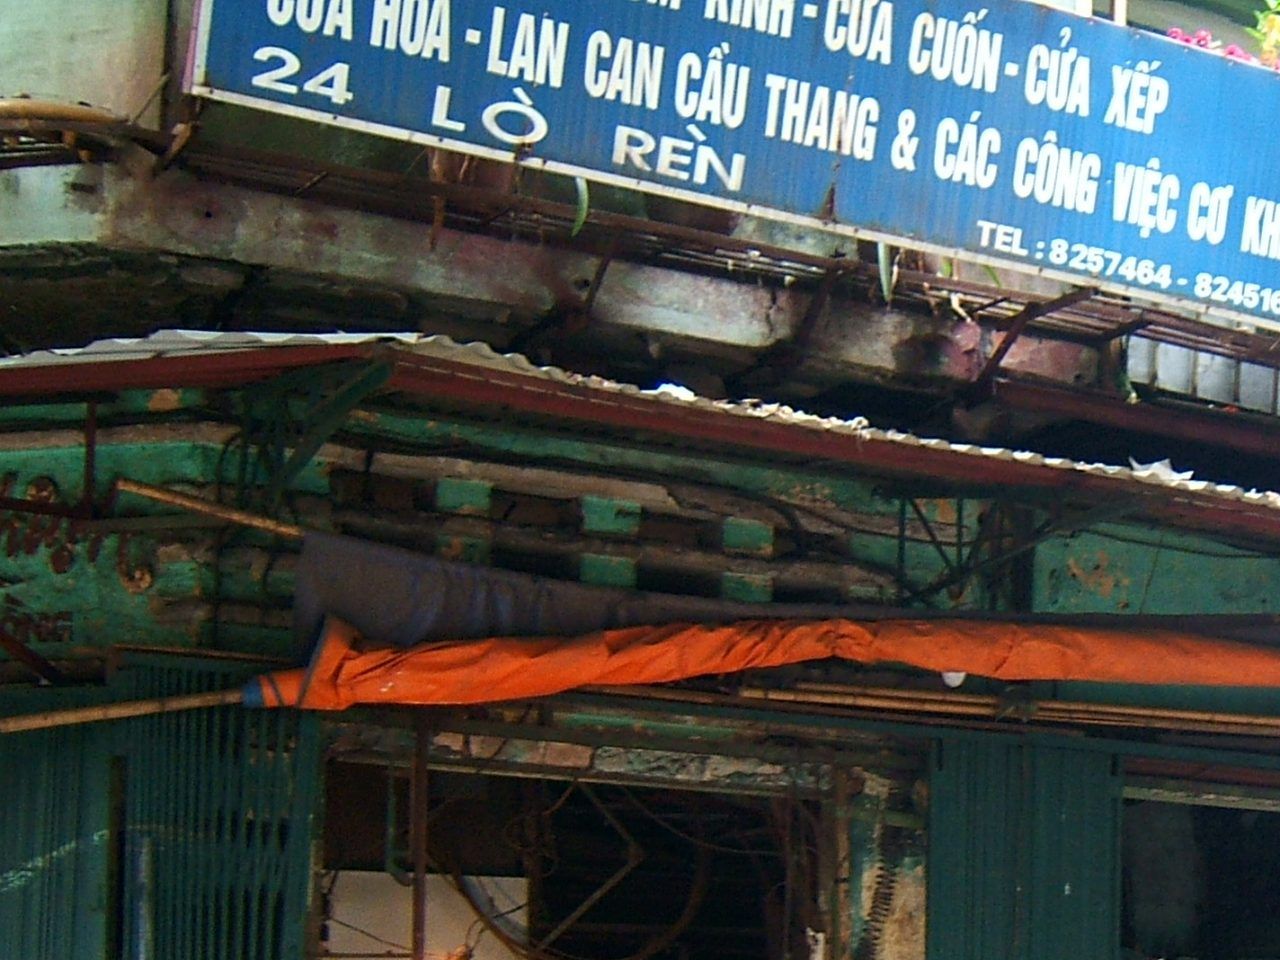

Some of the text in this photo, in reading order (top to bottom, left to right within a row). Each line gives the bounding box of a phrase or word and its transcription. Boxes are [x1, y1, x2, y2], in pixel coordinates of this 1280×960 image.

[251, 46, 353, 104] 24
[612, 124, 746, 191] RÈN
[487, 6, 569, 88] LAN
[584, 30, 665, 110] CAN
[675, 42, 750, 129] CẦU
[764, 74, 880, 161] THANG
[890, 109, 919, 172] &
[934, 111, 1002, 189] CÁC
[1013, 130, 1102, 214] CÔNG
[1113, 157, 1180, 239] VIỆC
[1186, 182, 1234, 245] CƠ
[908, 8, 1003, 93] CUỐN
[1024, 27, 1090, 117] CỬA
[1103, 60, 1170, 135] XẾP
